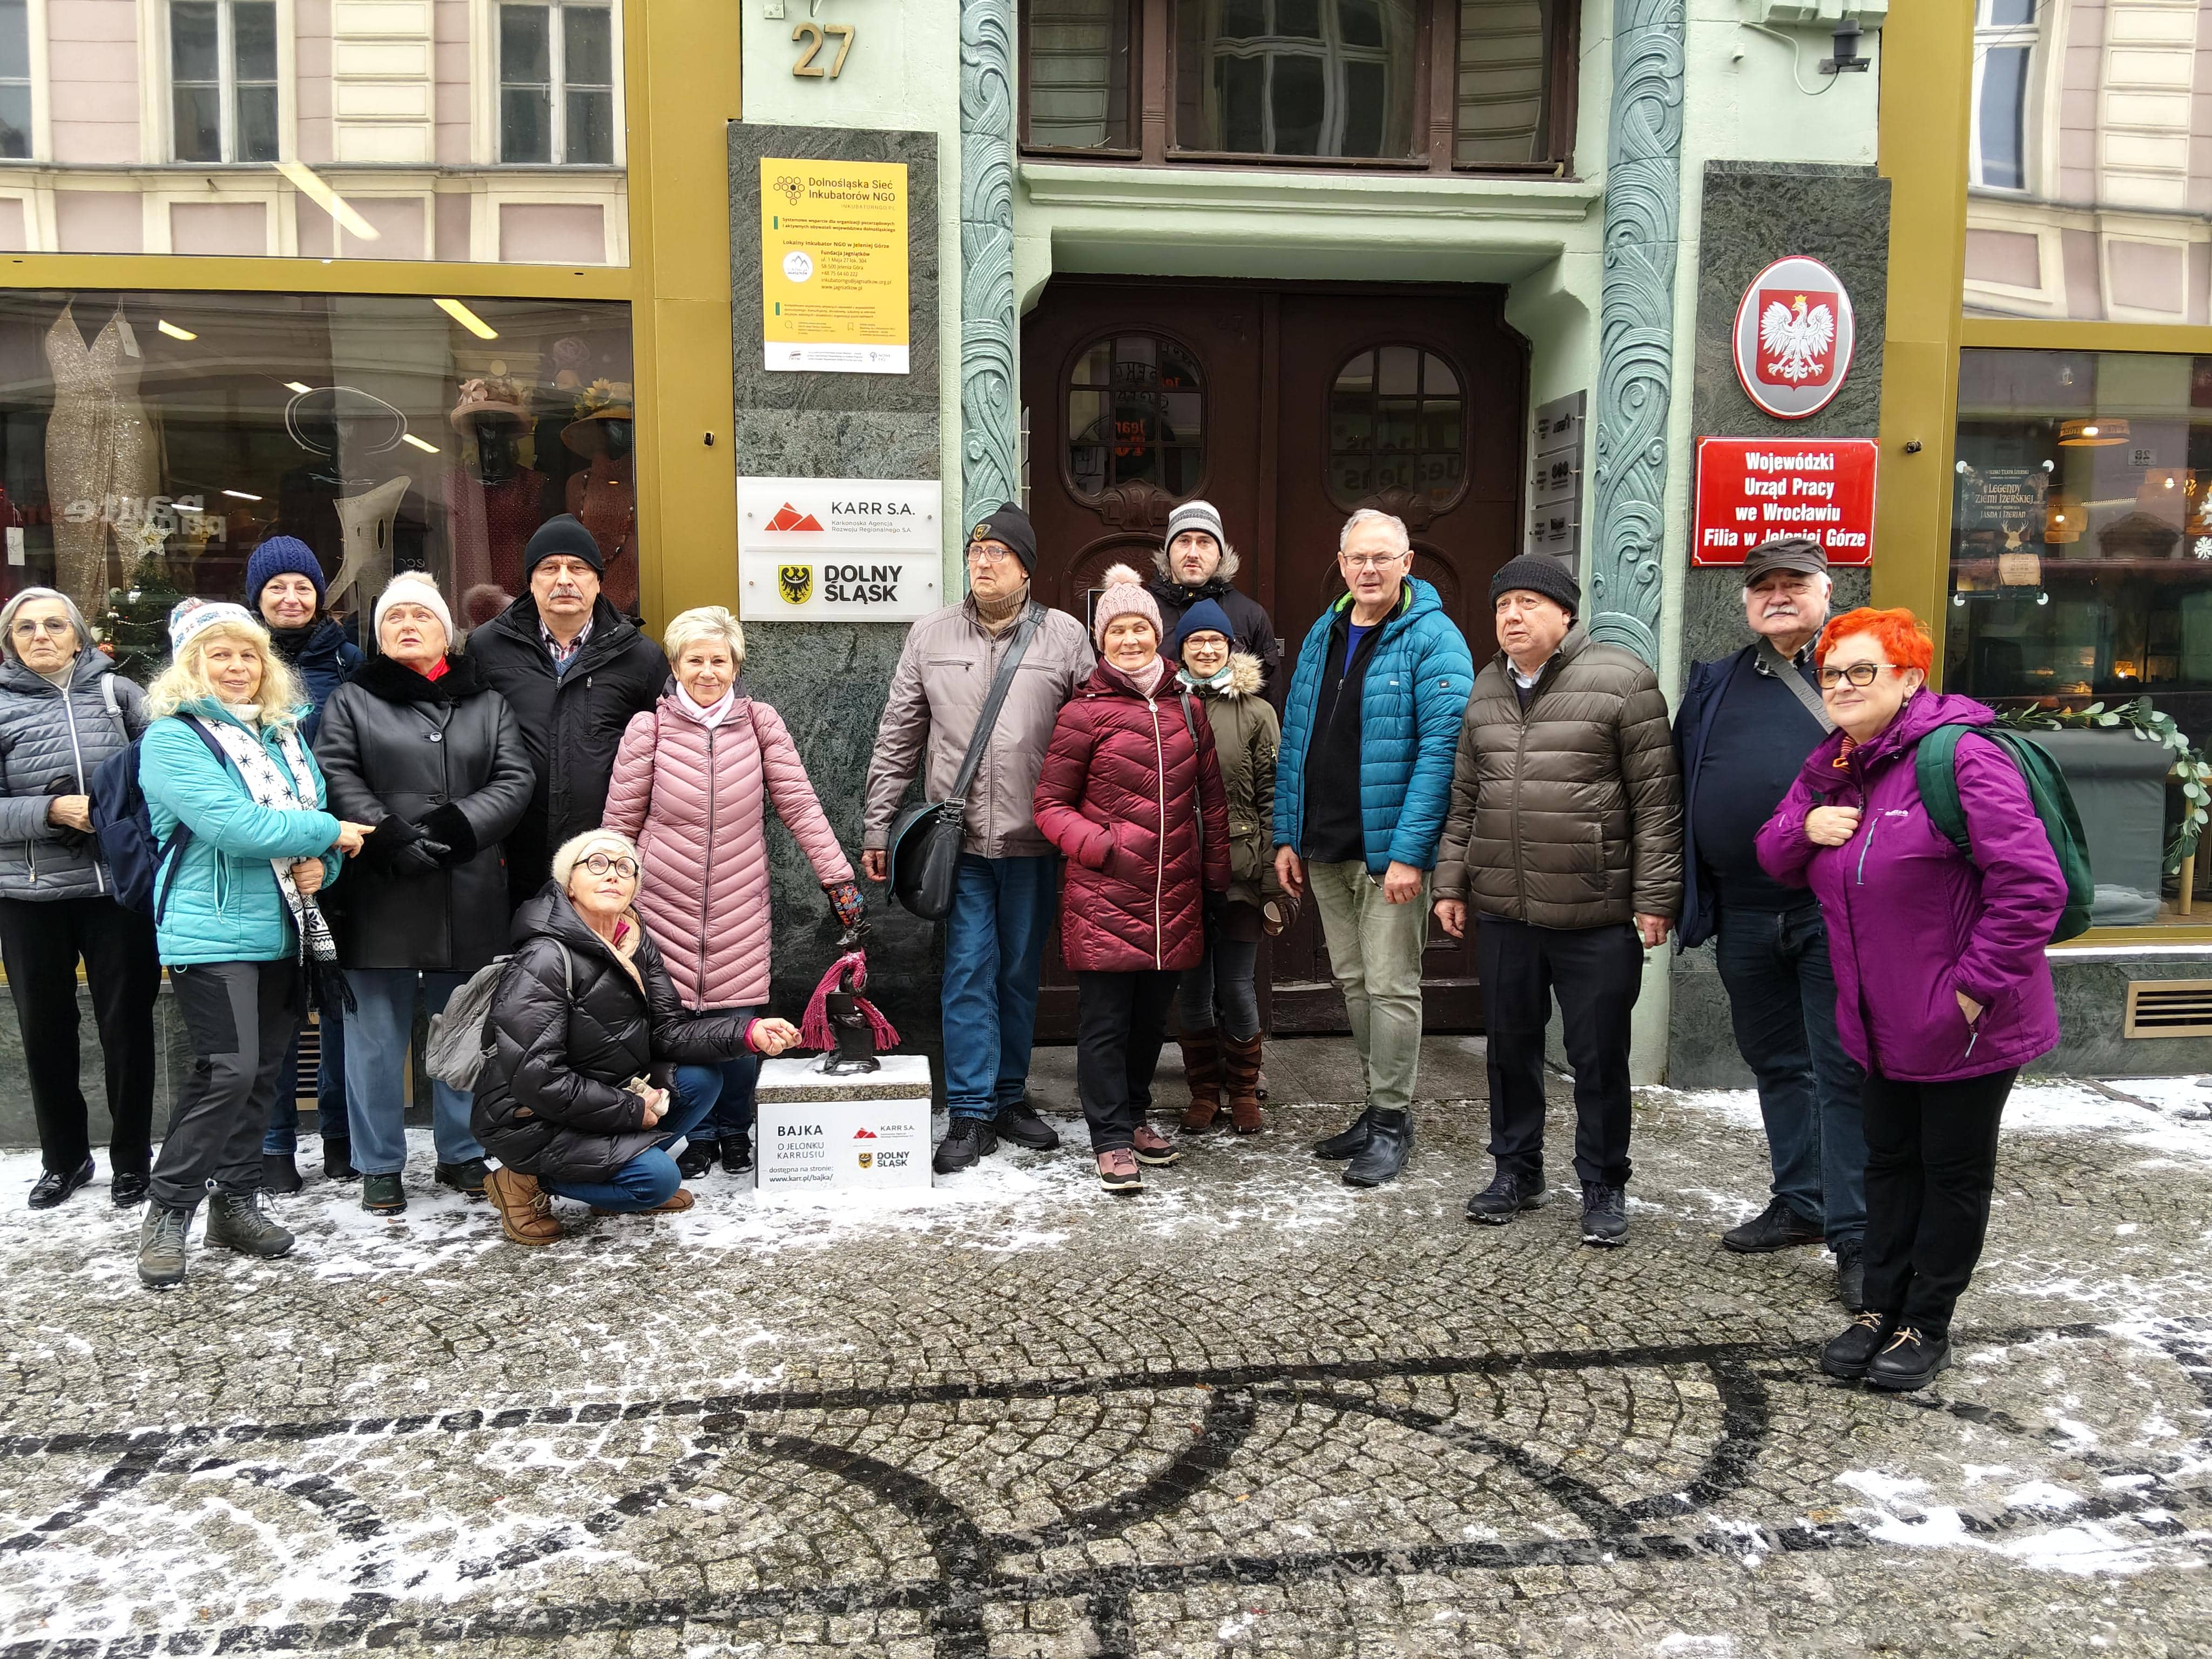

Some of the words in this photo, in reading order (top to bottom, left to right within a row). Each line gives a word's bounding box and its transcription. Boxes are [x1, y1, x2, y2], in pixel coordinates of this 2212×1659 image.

[792, 22, 855, 79] 27
[809, 178, 869, 190] Dolnośląska
[872, 180, 893, 190] Sieć
[809, 190, 869, 200] Inkubatorów
[873, 192, 895, 201] NGO
[1745, 452, 1835, 474] Wojewódzki
[1744, 477, 1787, 500] Urząd
[1792, 477, 1835, 500] Pracy
[1975, 494, 1997, 503] ZIEMI
[832, 502, 882, 515] KARR
[887, 503, 915, 515] S.A.
[1735, 507, 1757, 521] we
[1763, 503, 1841, 521] Wrocławiu
[1704, 528, 1738, 547] Filia
[1743, 532, 1757, 546] w
[1826, 529, 1866, 547] Górze
[824, 565, 903, 583] DOLNY
[824, 580, 898, 605] ŚLĄSK
[778, 1125, 823, 1137] BAJKA
[787, 1142, 825, 1150] JELONKU
[777, 1151, 825, 1159] KARRUSIU
[877, 1151, 910, 1160] DOLNY
[877, 1158, 907, 1168] ŚLĄSK
[769, 1174, 833, 1182] www.karr.pl/bajka/
